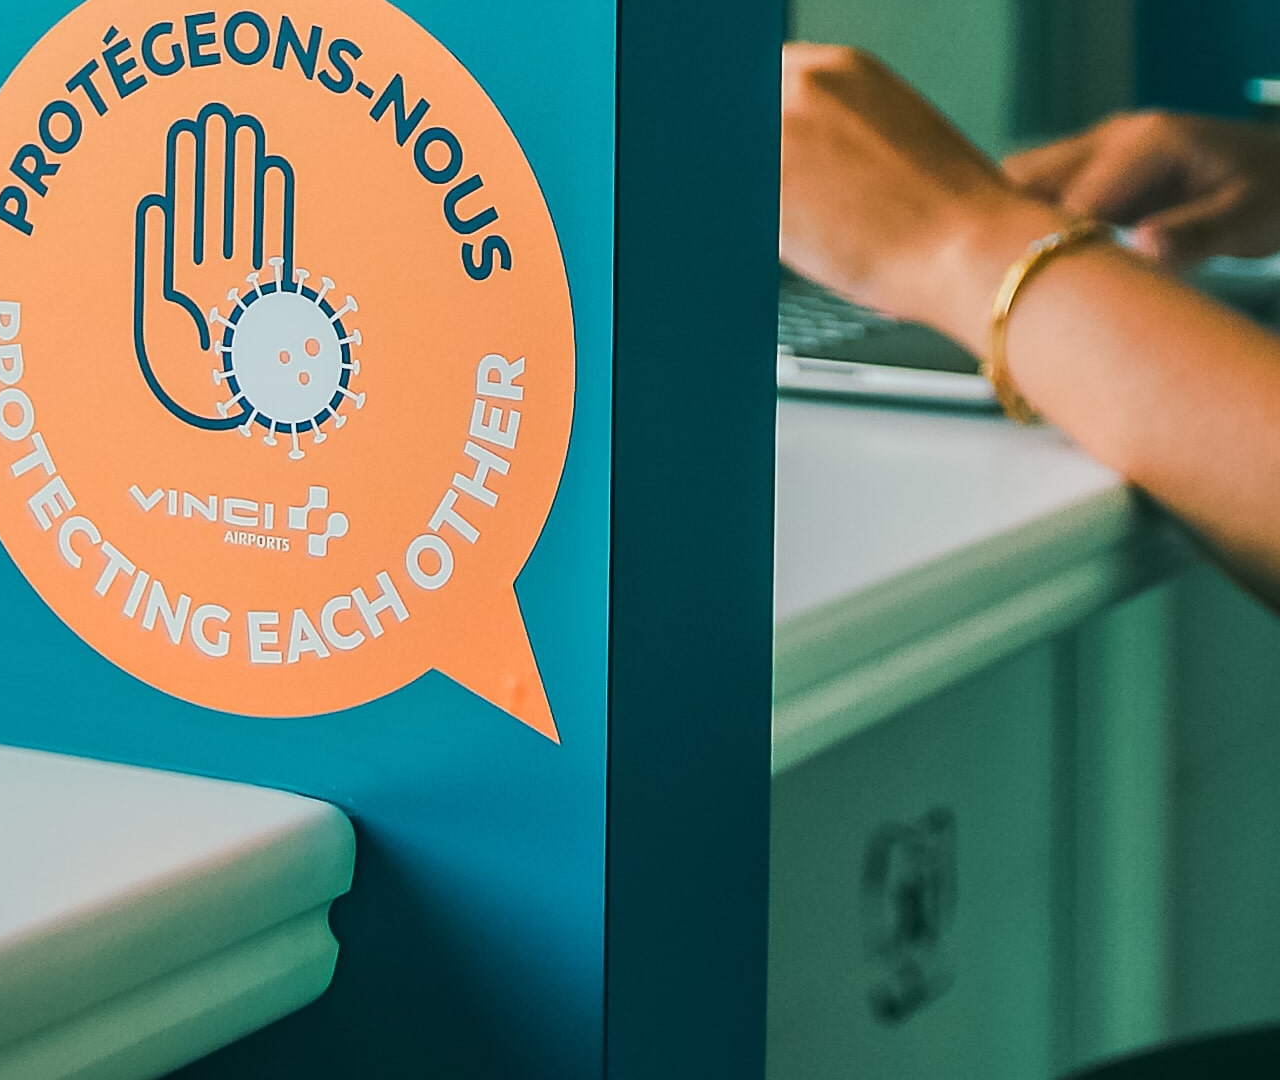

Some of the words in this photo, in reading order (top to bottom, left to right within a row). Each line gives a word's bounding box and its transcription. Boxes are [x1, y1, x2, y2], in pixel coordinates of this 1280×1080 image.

[128, 484, 274, 529] VINCI
[246, 571, 409, 665] EACH
[405, 352, 526, 590] OTHER
[223, 530, 290, 552] AIRPORTS
